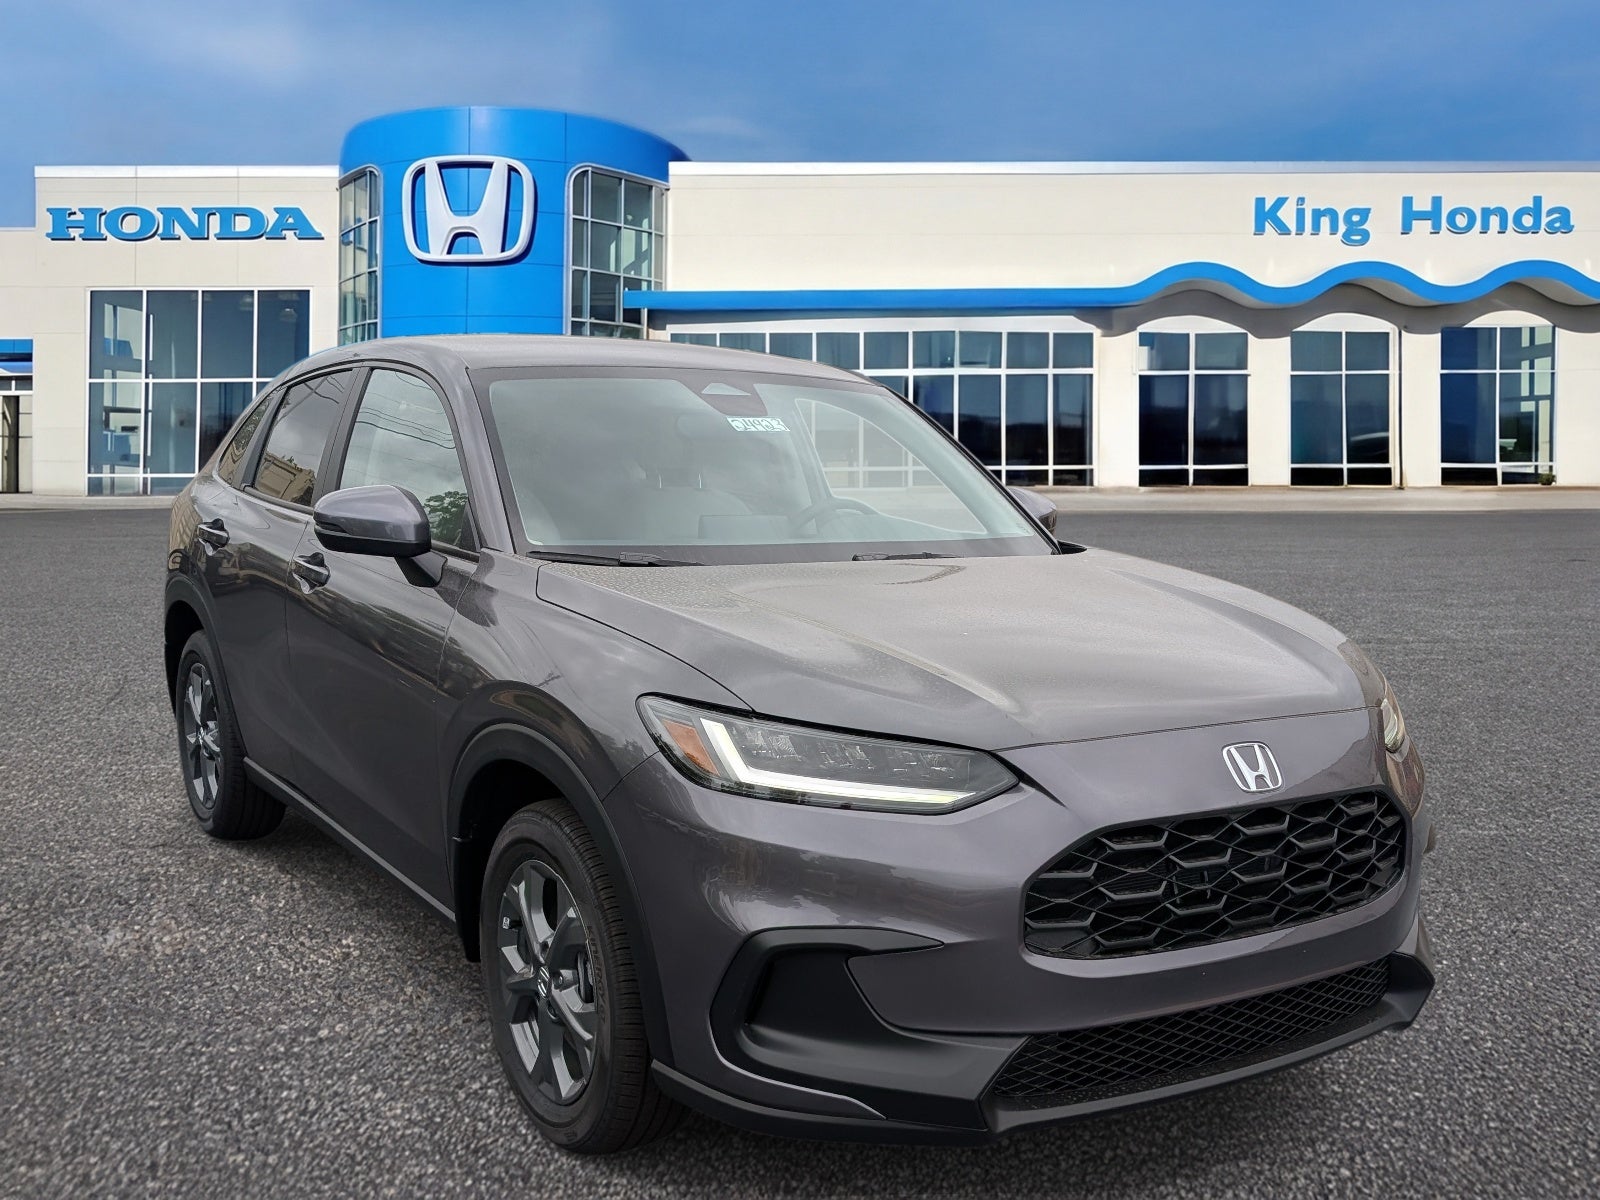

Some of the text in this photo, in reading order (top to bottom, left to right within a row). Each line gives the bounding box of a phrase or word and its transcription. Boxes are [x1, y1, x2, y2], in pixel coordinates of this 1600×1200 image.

[45, 206, 325, 241] HONDA
[1253, 195, 1575, 247] King Honda
